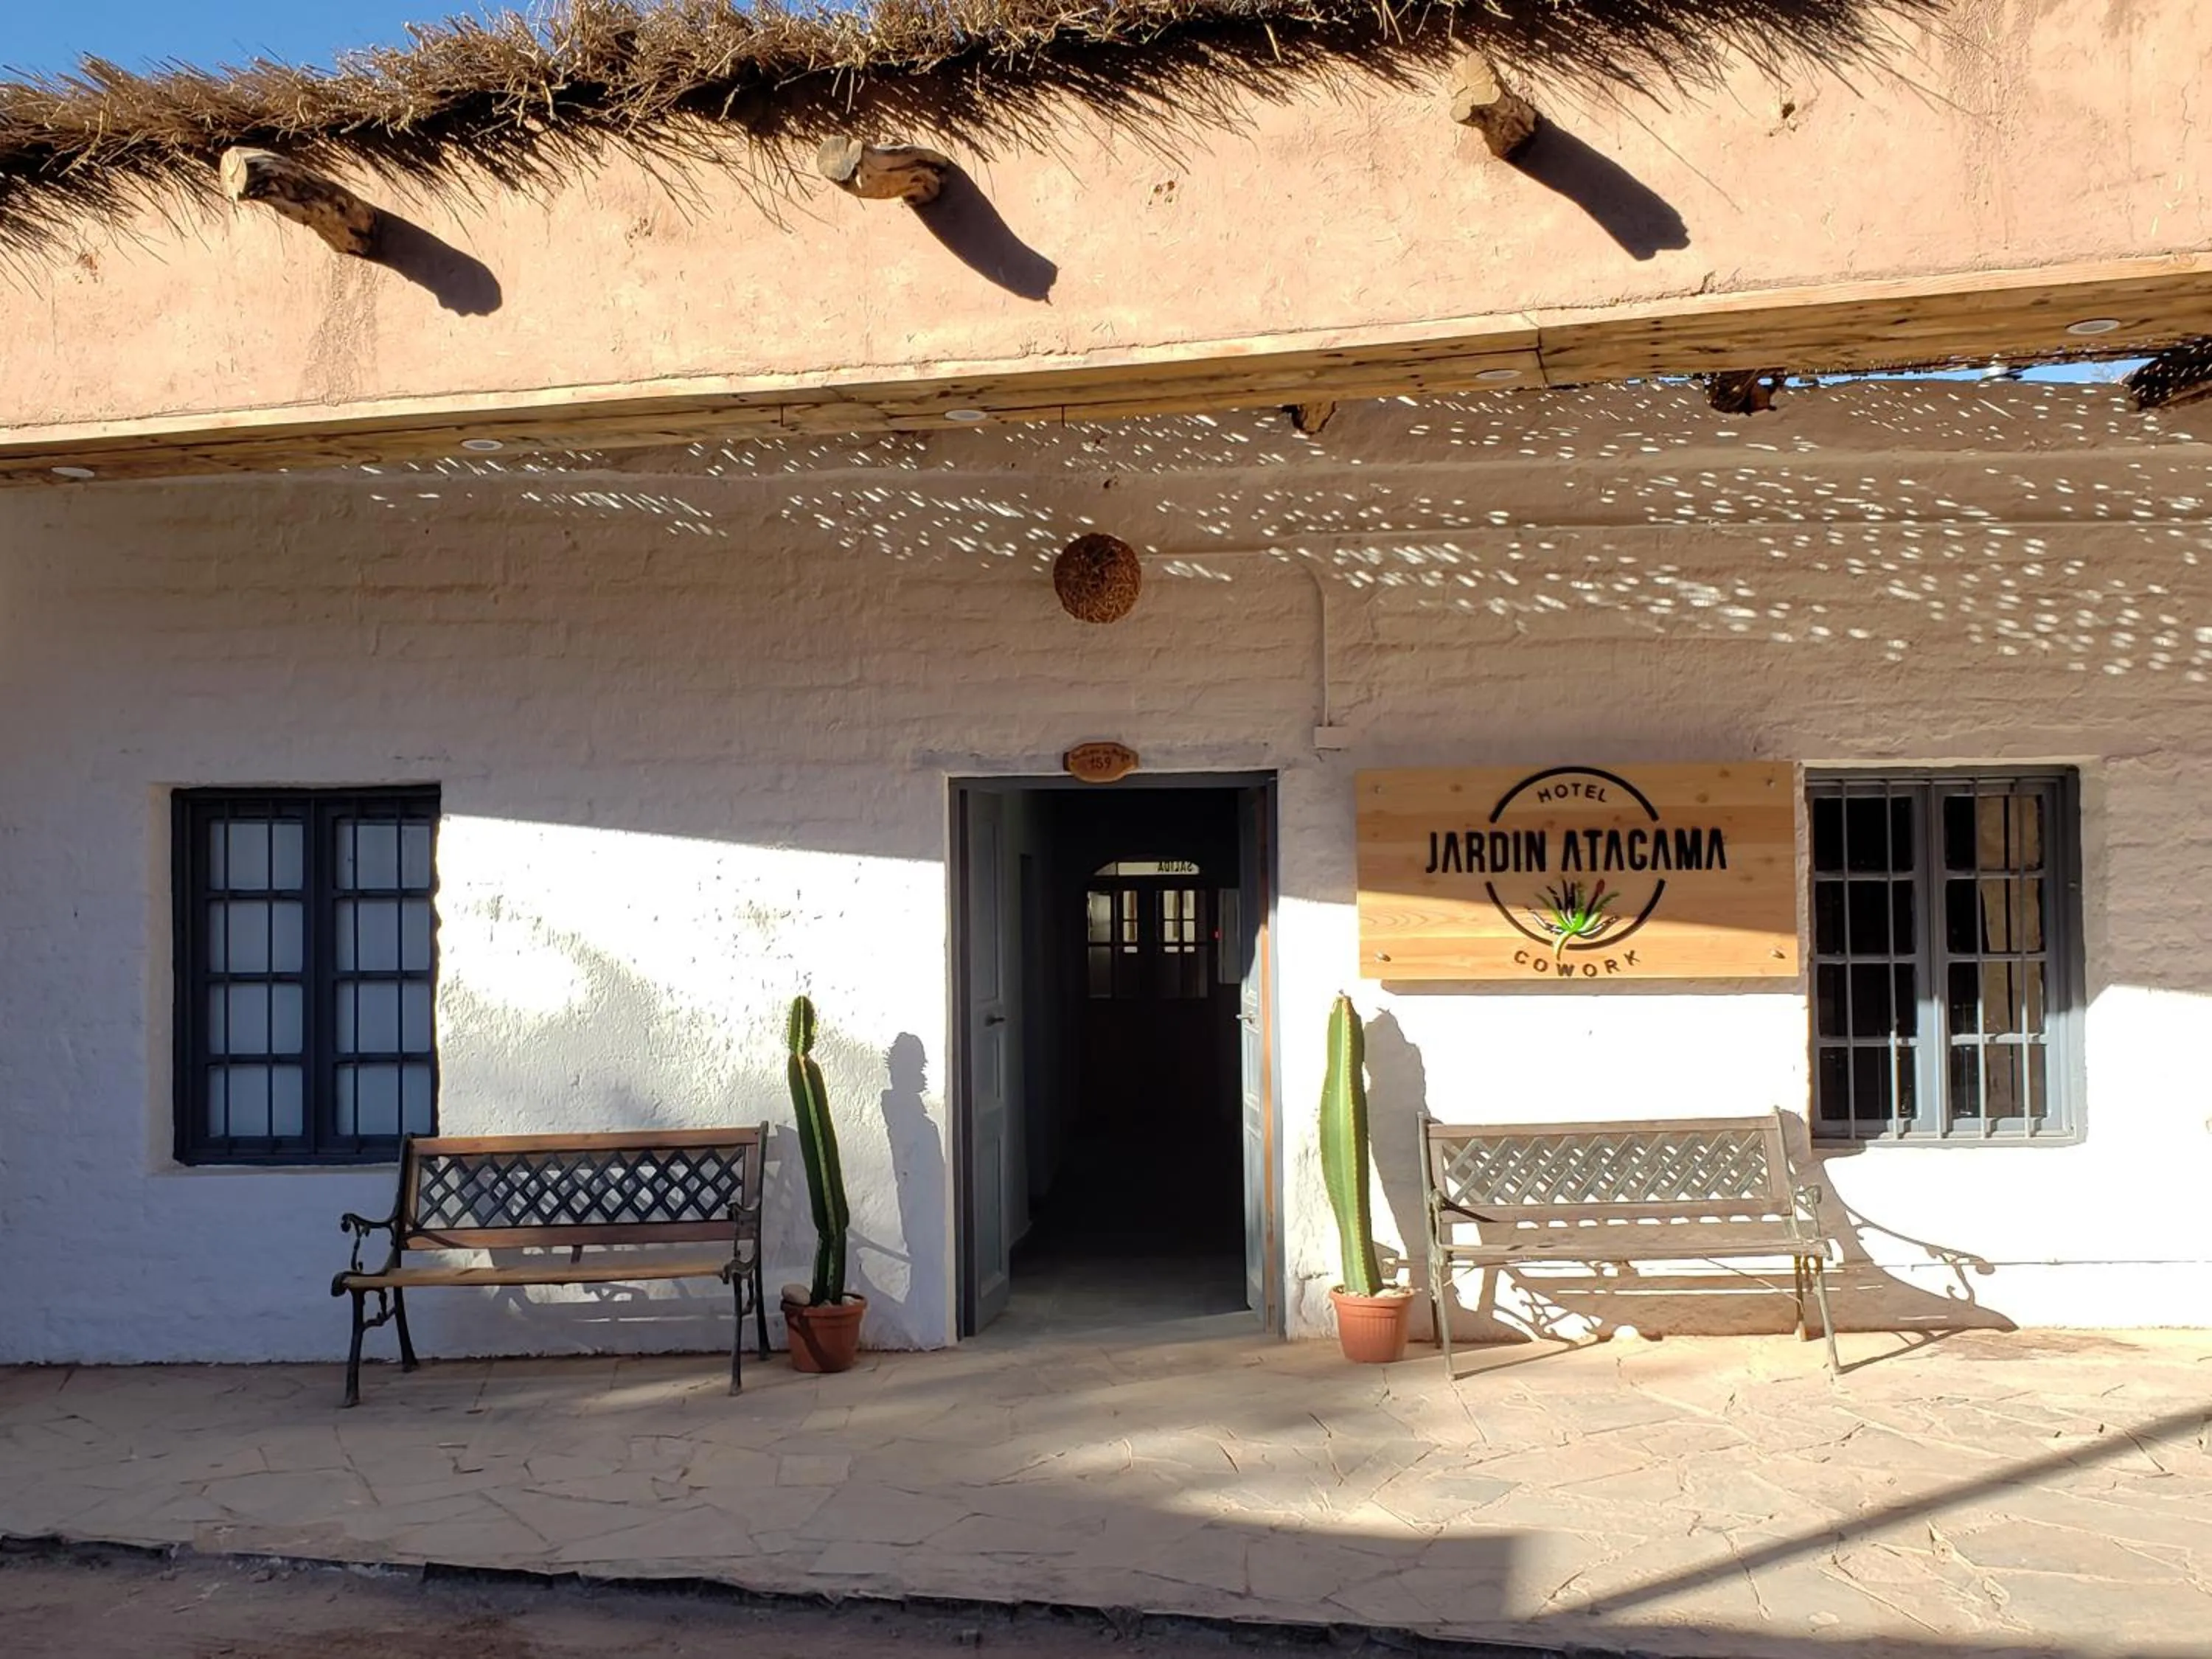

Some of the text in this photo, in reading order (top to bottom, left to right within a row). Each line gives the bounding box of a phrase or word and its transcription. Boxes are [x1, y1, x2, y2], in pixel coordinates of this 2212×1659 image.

[1537, 782, 1607, 804] HOTEL
[1425, 828, 1728, 874] JARDIN ATACAMA
[1514, 950, 1641, 978] COWORK
